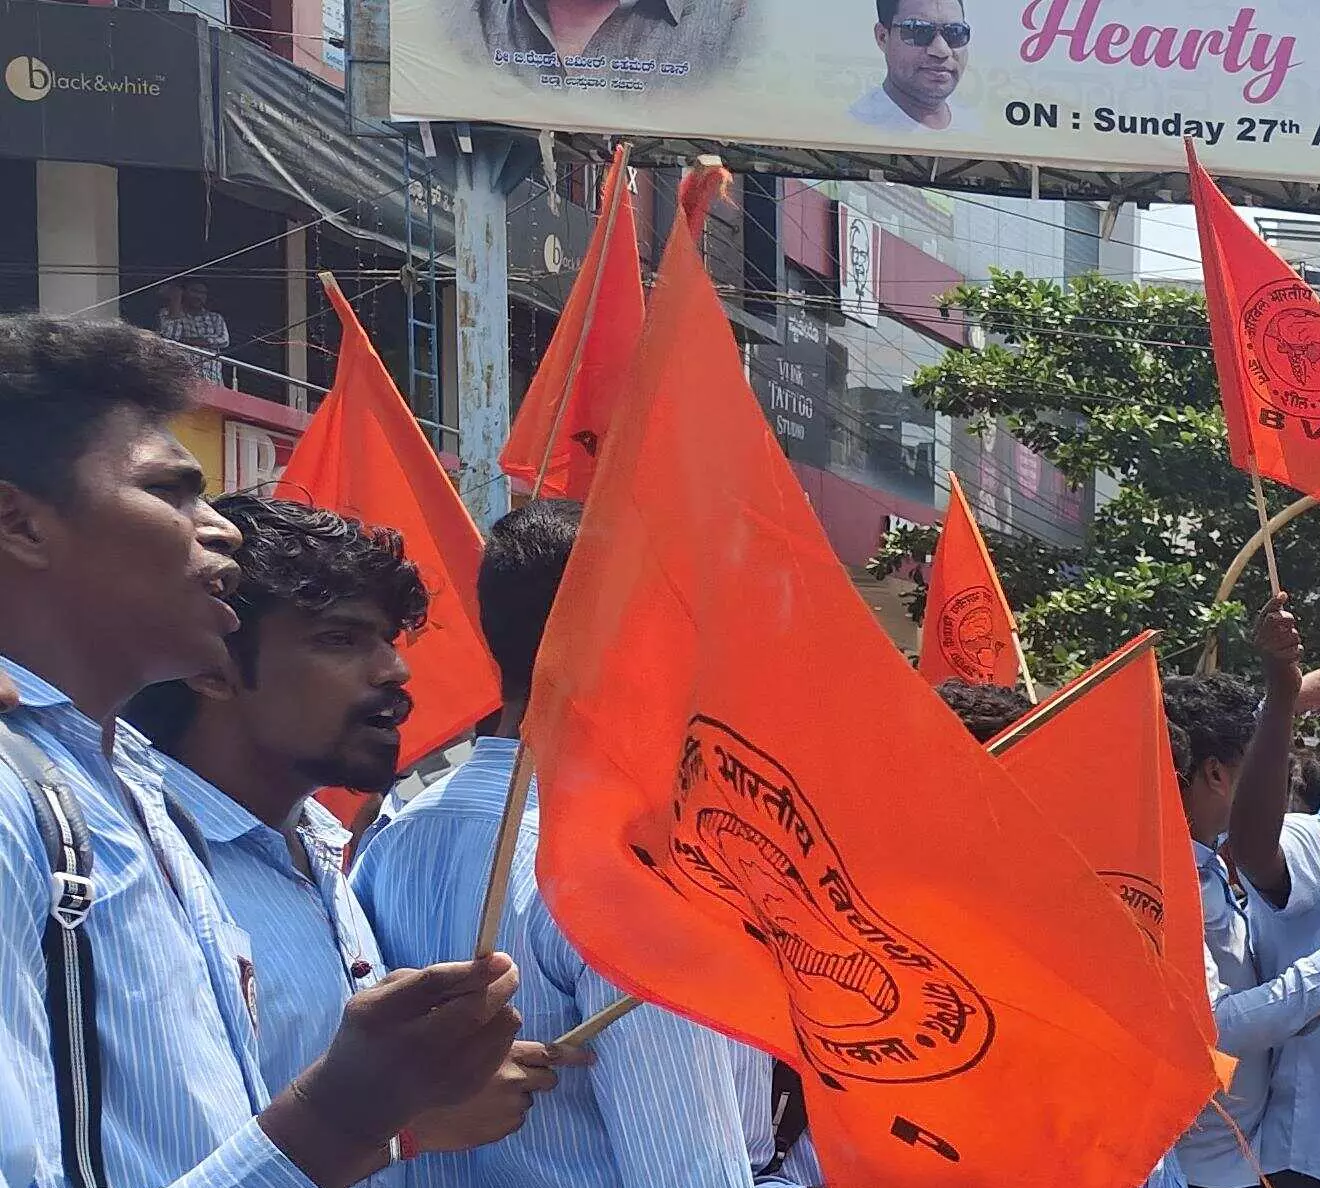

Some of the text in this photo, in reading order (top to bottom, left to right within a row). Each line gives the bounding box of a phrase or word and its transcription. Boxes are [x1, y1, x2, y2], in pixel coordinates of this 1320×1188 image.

[1021, 0, 1299, 103] Hearty
[1005, 102, 1058, 129] ON
[1093, 107, 1224, 146] Sunday
[1237, 117, 1301, 146] 27th
[769, 381, 813, 418] TATTOO
[777, 415, 805, 440] STUDIO
[714, 745, 815, 857] भारतीय
